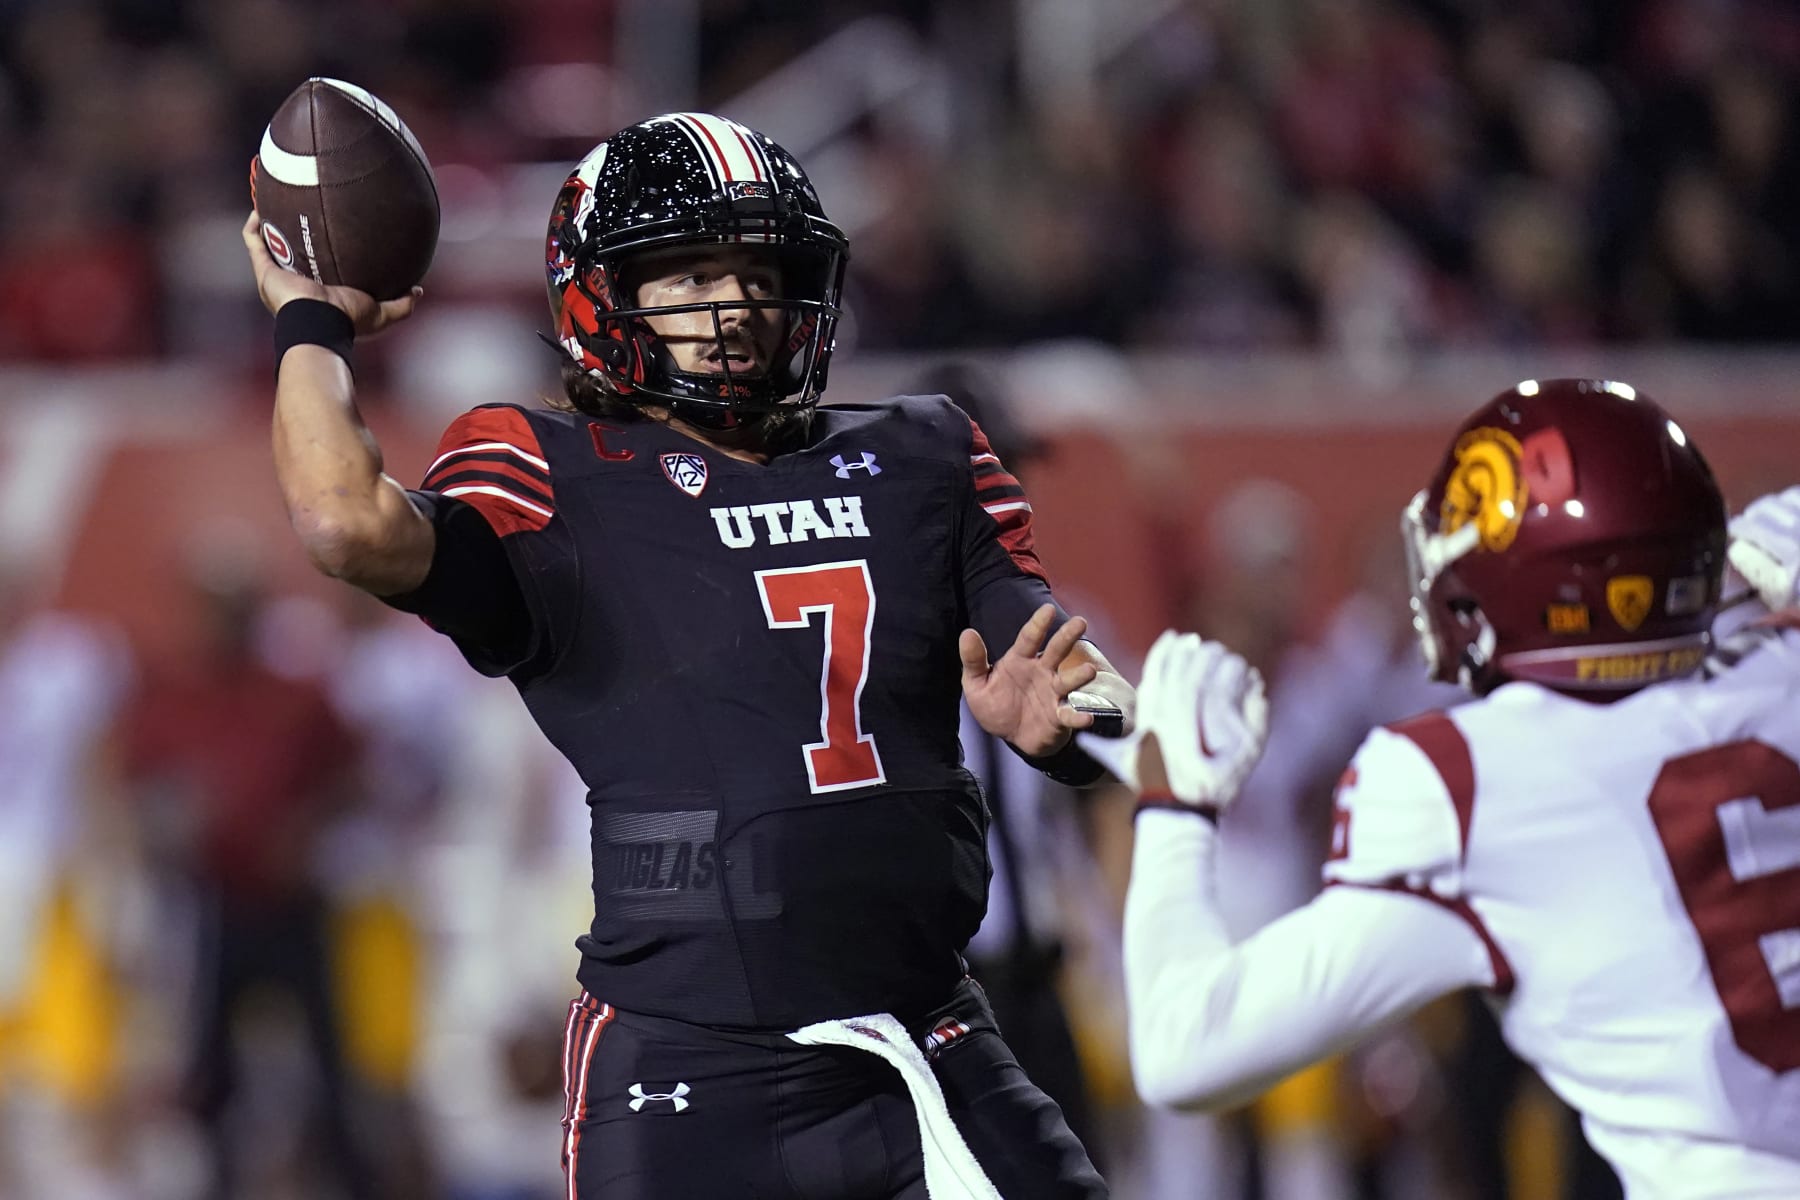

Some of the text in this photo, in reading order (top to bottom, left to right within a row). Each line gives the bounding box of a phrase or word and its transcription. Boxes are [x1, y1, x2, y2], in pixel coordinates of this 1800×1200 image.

[299, 213, 316, 258] ISSUE
[587, 422, 636, 462] C
[664, 453, 706, 478] PAC
[677, 471, 701, 488] 12
[710, 496, 871, 549] UTAH
[753, 559, 887, 796] 7
